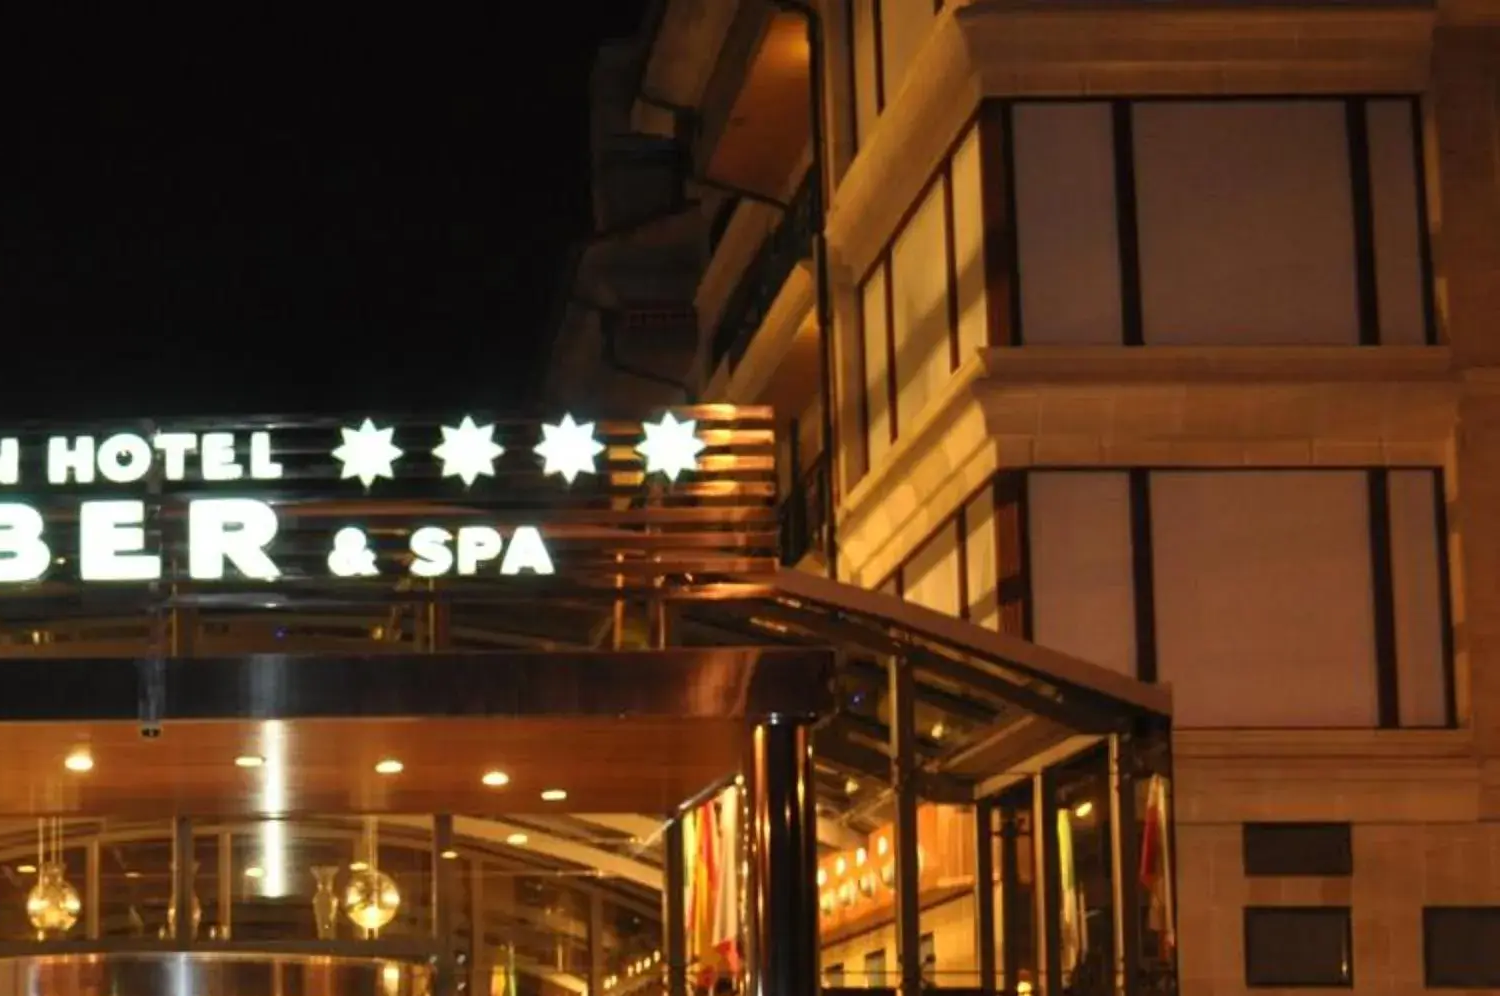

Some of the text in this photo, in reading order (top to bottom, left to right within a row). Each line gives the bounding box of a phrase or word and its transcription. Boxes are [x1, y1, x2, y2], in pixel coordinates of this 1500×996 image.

[46, 431, 284, 484] HOTEL
[326, 526, 380, 577] &
[409, 525, 556, 577] SPA
